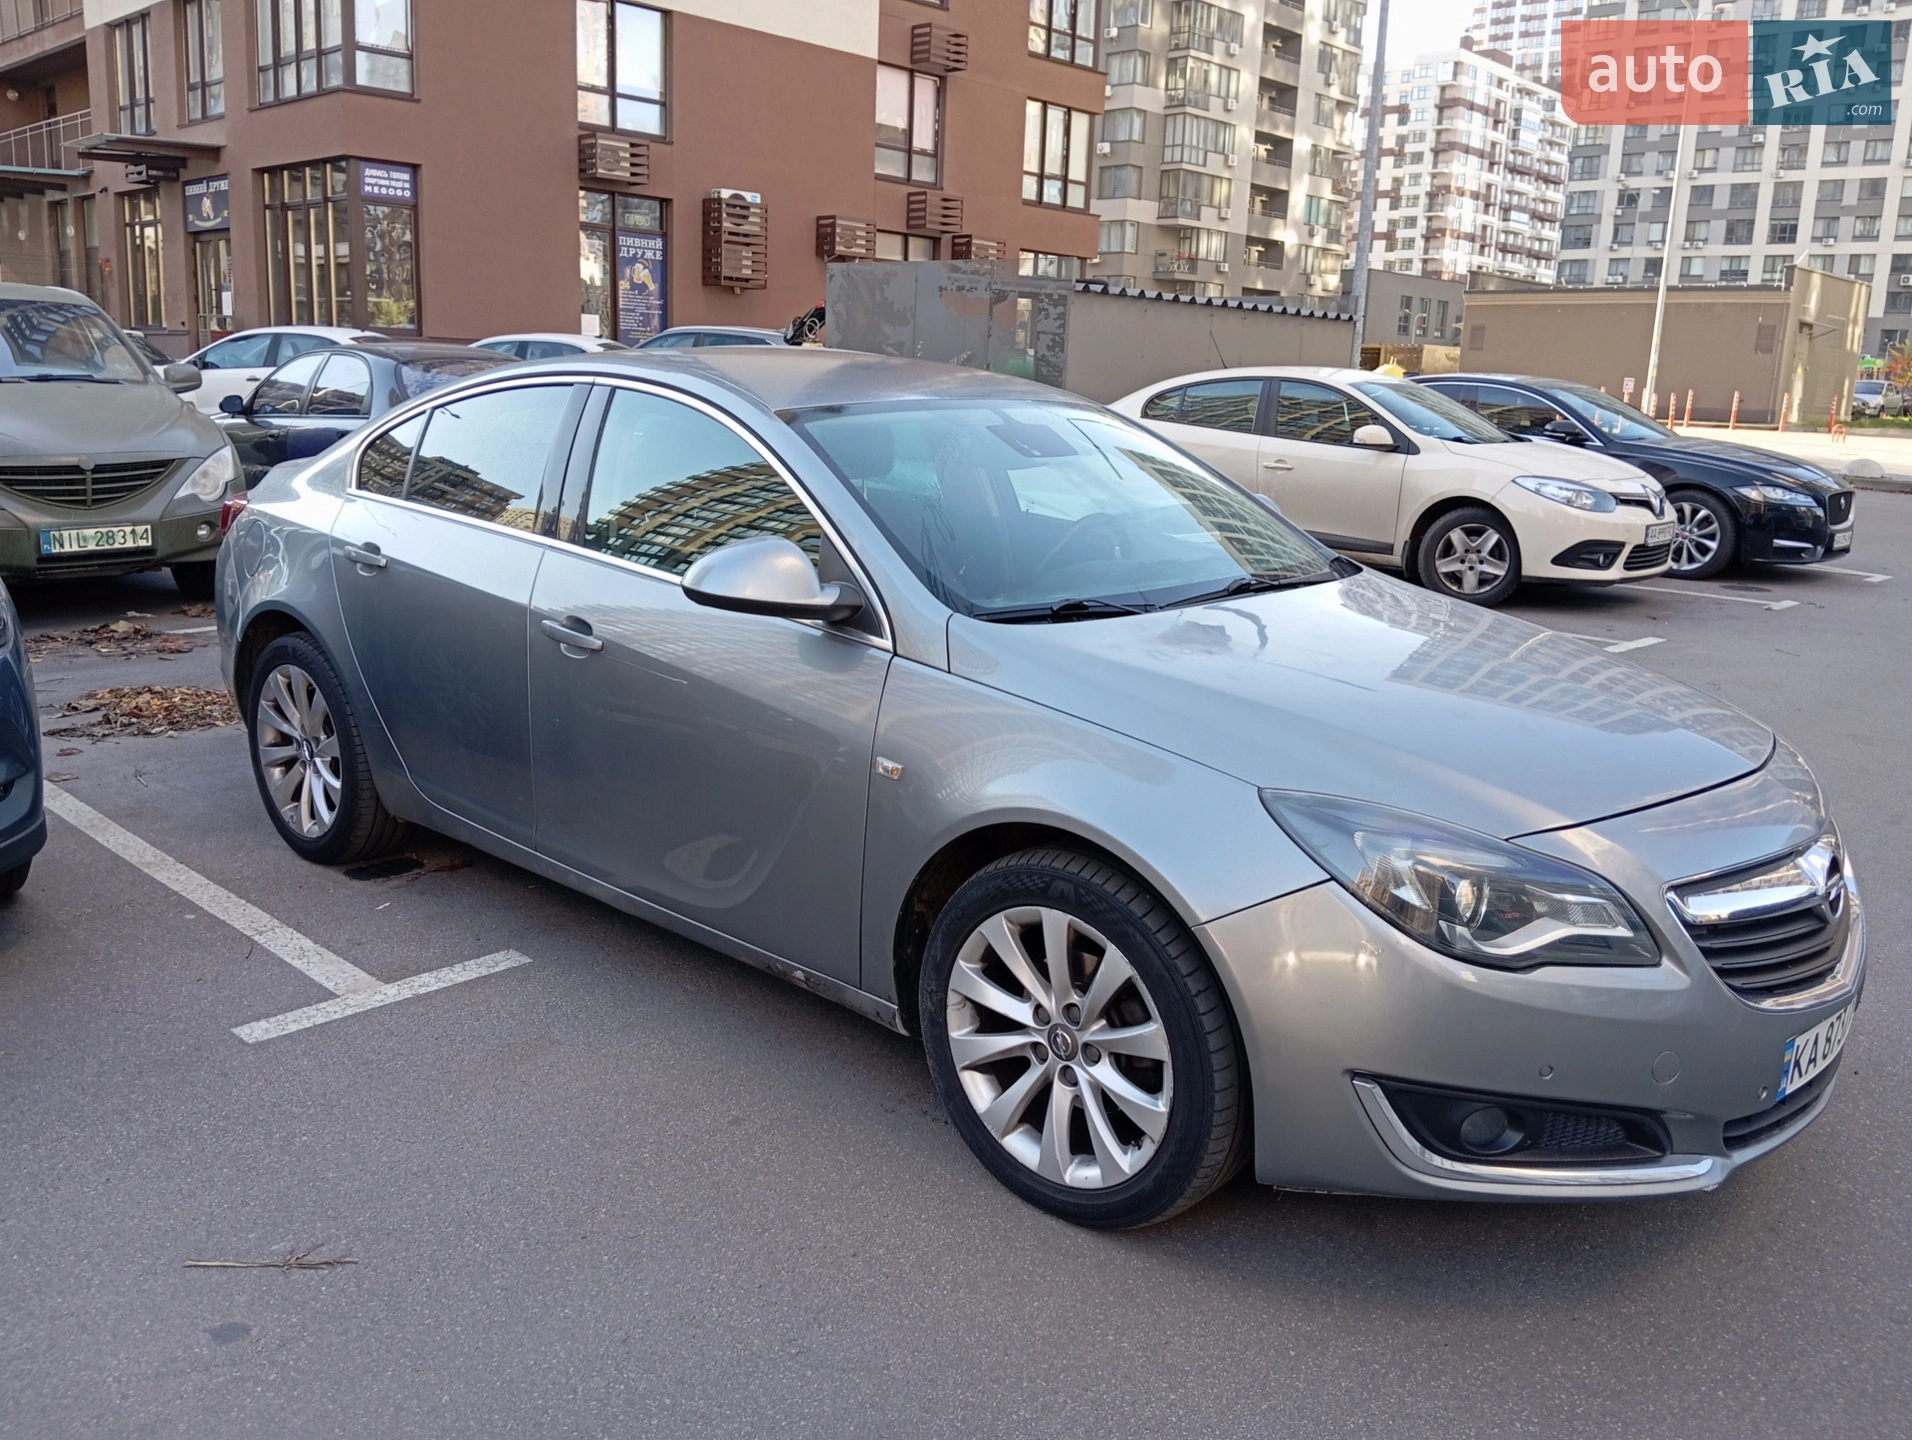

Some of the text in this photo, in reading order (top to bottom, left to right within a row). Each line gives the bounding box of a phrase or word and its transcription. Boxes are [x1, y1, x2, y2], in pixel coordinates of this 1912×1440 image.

[364, 185, 411, 197] MEGOGO
[618, 236, 663, 250] ПИВНИЙ
[618, 246, 663, 260] ДРУЖЕ
[52, 527, 149, 550] NIL 28314
[1789, 1032, 1819, 1085] KA
